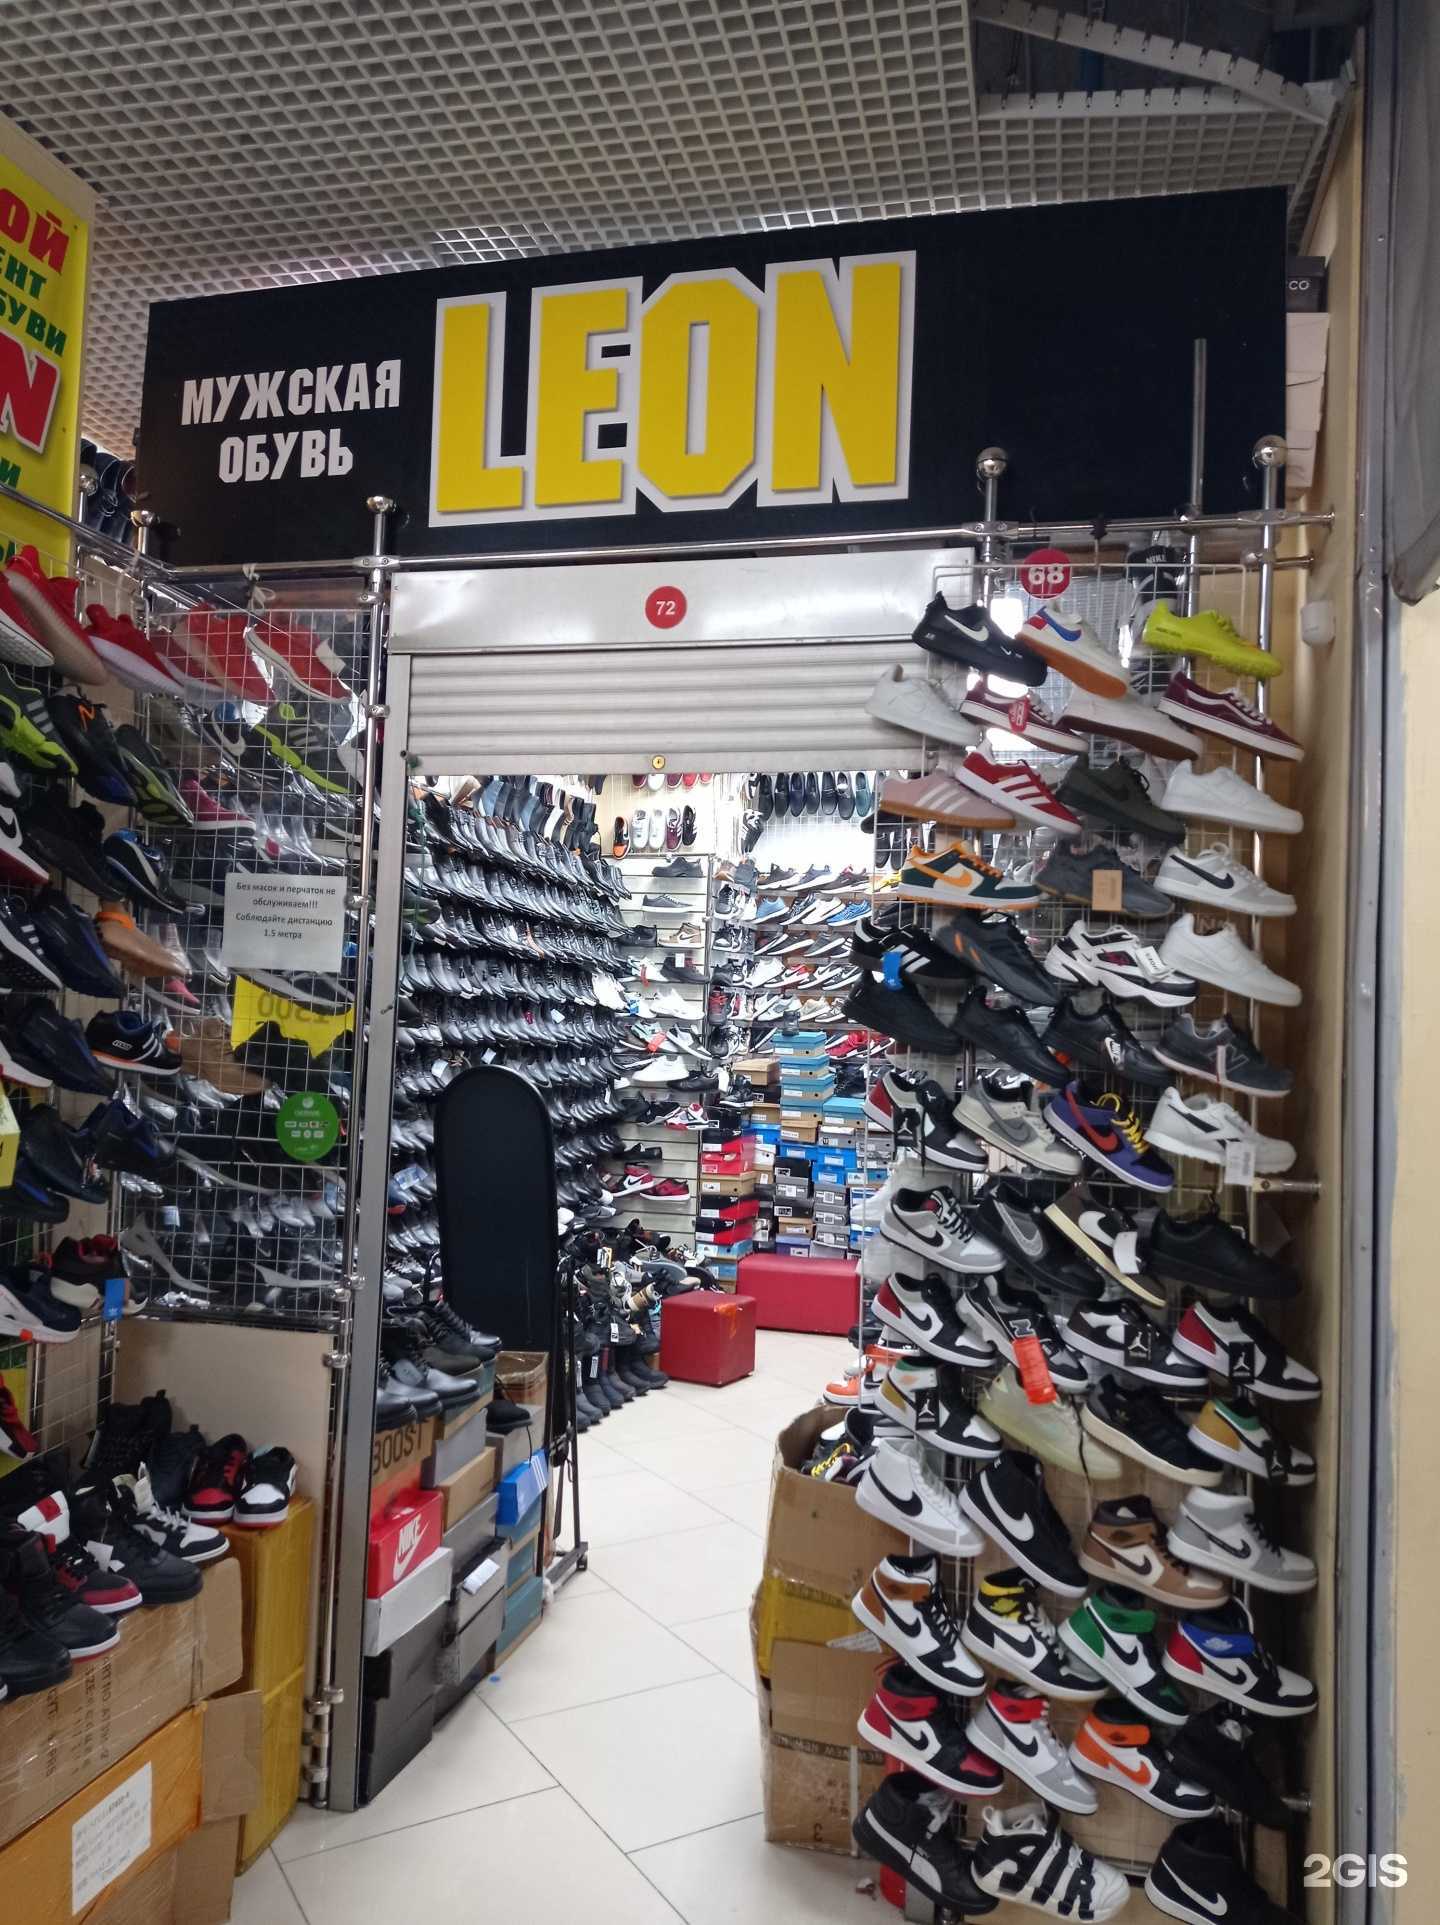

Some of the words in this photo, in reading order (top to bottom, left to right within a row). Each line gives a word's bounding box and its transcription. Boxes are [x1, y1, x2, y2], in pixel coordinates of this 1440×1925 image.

[181, 359, 401, 426] МУЖСКАЯ
[430, 250, 916, 527] LEON
[218, 428, 354, 483] ОБУВЬ
[1028, 562, 1065, 585] 68
[656, 600, 676, 616] 72
[236, 882, 250, 890] Без
[286, 886, 324, 895] перчаток
[235, 912, 285, 924] Соблюдайте
[287, 917, 333, 926] дистанцию
[264, 929, 276, 937] 1.5
[277, 931, 302, 940] метра
